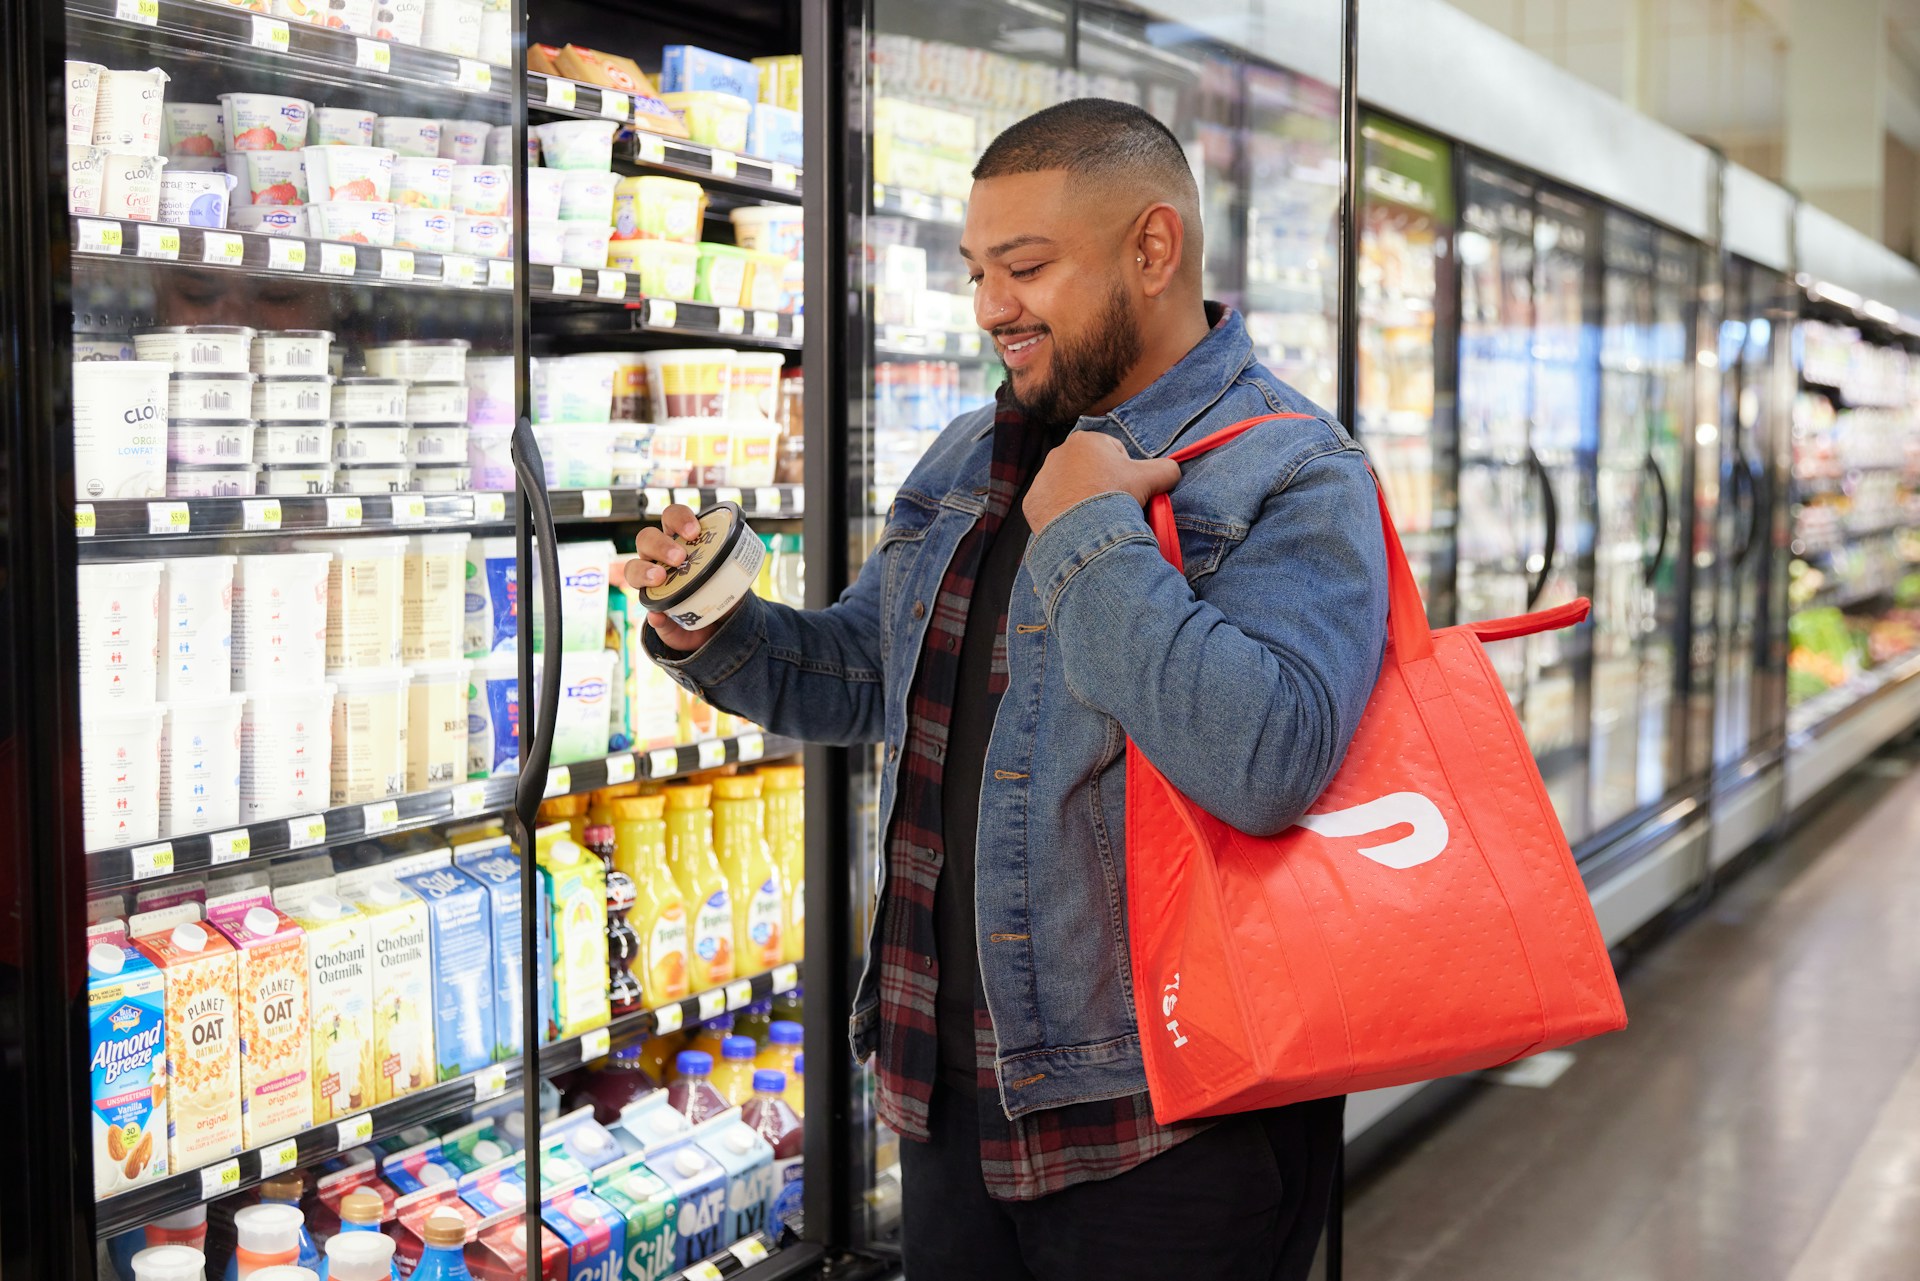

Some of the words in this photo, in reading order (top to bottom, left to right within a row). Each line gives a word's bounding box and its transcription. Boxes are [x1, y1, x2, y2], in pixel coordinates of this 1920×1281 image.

[265, 214, 297, 224] FAGE
[103, 230, 120, 242] $1.49
[161, 237, 178, 249] $1.49
[416, 870, 466, 899] Silk
[376, 928, 424, 954] Chobani
[314, 943, 365, 970] Chobani
[380, 946, 422, 968] Oatmilk
[318, 962, 363, 985] Oatmilk
[259, 978, 296, 1000] PLANET
[187, 997, 225, 1020] PLANET
[263, 998, 295, 1026] OAT
[191, 1017, 225, 1046] OAT
[266, 1024, 294, 1038] OATMILK
[90, 1019, 162, 1073] Almond
[195, 1044, 224, 1059] OATMILK
[105, 1048, 153, 1085] Breeze
[106, 1088, 151, 1107] UNSWEETENED
[117, 1101, 143, 1115] Vanilla
[267, 1089, 299, 1106] original
[196, 1110, 229, 1130] original
[627, 1223, 677, 1281] Silk
